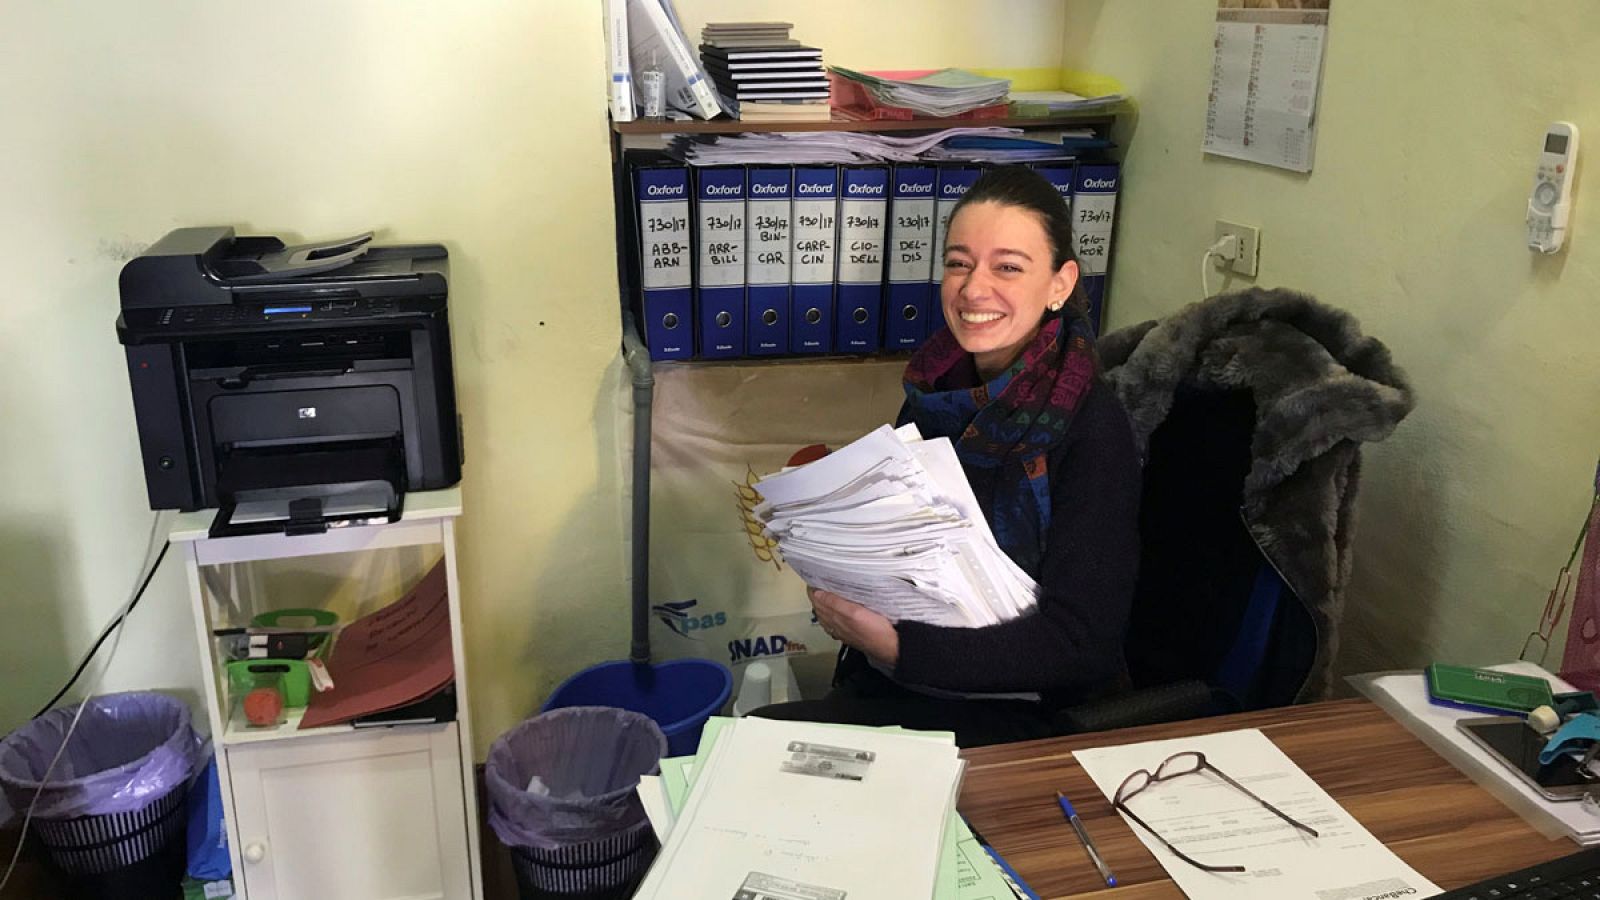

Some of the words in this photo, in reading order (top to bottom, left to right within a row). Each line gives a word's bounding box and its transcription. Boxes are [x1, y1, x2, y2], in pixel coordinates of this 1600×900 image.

[752, 183, 788, 195] Oxford
[798, 183, 833, 194] Oxford
[848, 183, 883, 195] Oxford
[899, 183, 932, 194] Oxford
[1084, 178, 1116, 189] Oxford
[647, 184, 684, 196] Oxford
[706, 184, 742, 196] Oxford
[648, 216, 686, 233] 730/17
[706, 213, 742, 231] 730/17
[755, 215, 788, 232] 730/17
[799, 212, 833, 230] 730/17
[846, 215, 879, 229] 730/17
[898, 214, 930, 231] 730/17
[760, 231, 787, 242] BIN-
[652, 242, 688, 257] ABB-
[709, 243, 738, 255] ARR-
[796, 240, 831, 252] CARP-
[899, 240, 928, 251] DEL-
[654, 256, 680, 269] ARN
[711, 255, 738, 265] BILL
[758, 251, 785, 265] CAR
[801, 254, 824, 265] CIN
[850, 255, 879, 264] DELL
[902, 252, 922, 264] DIS
